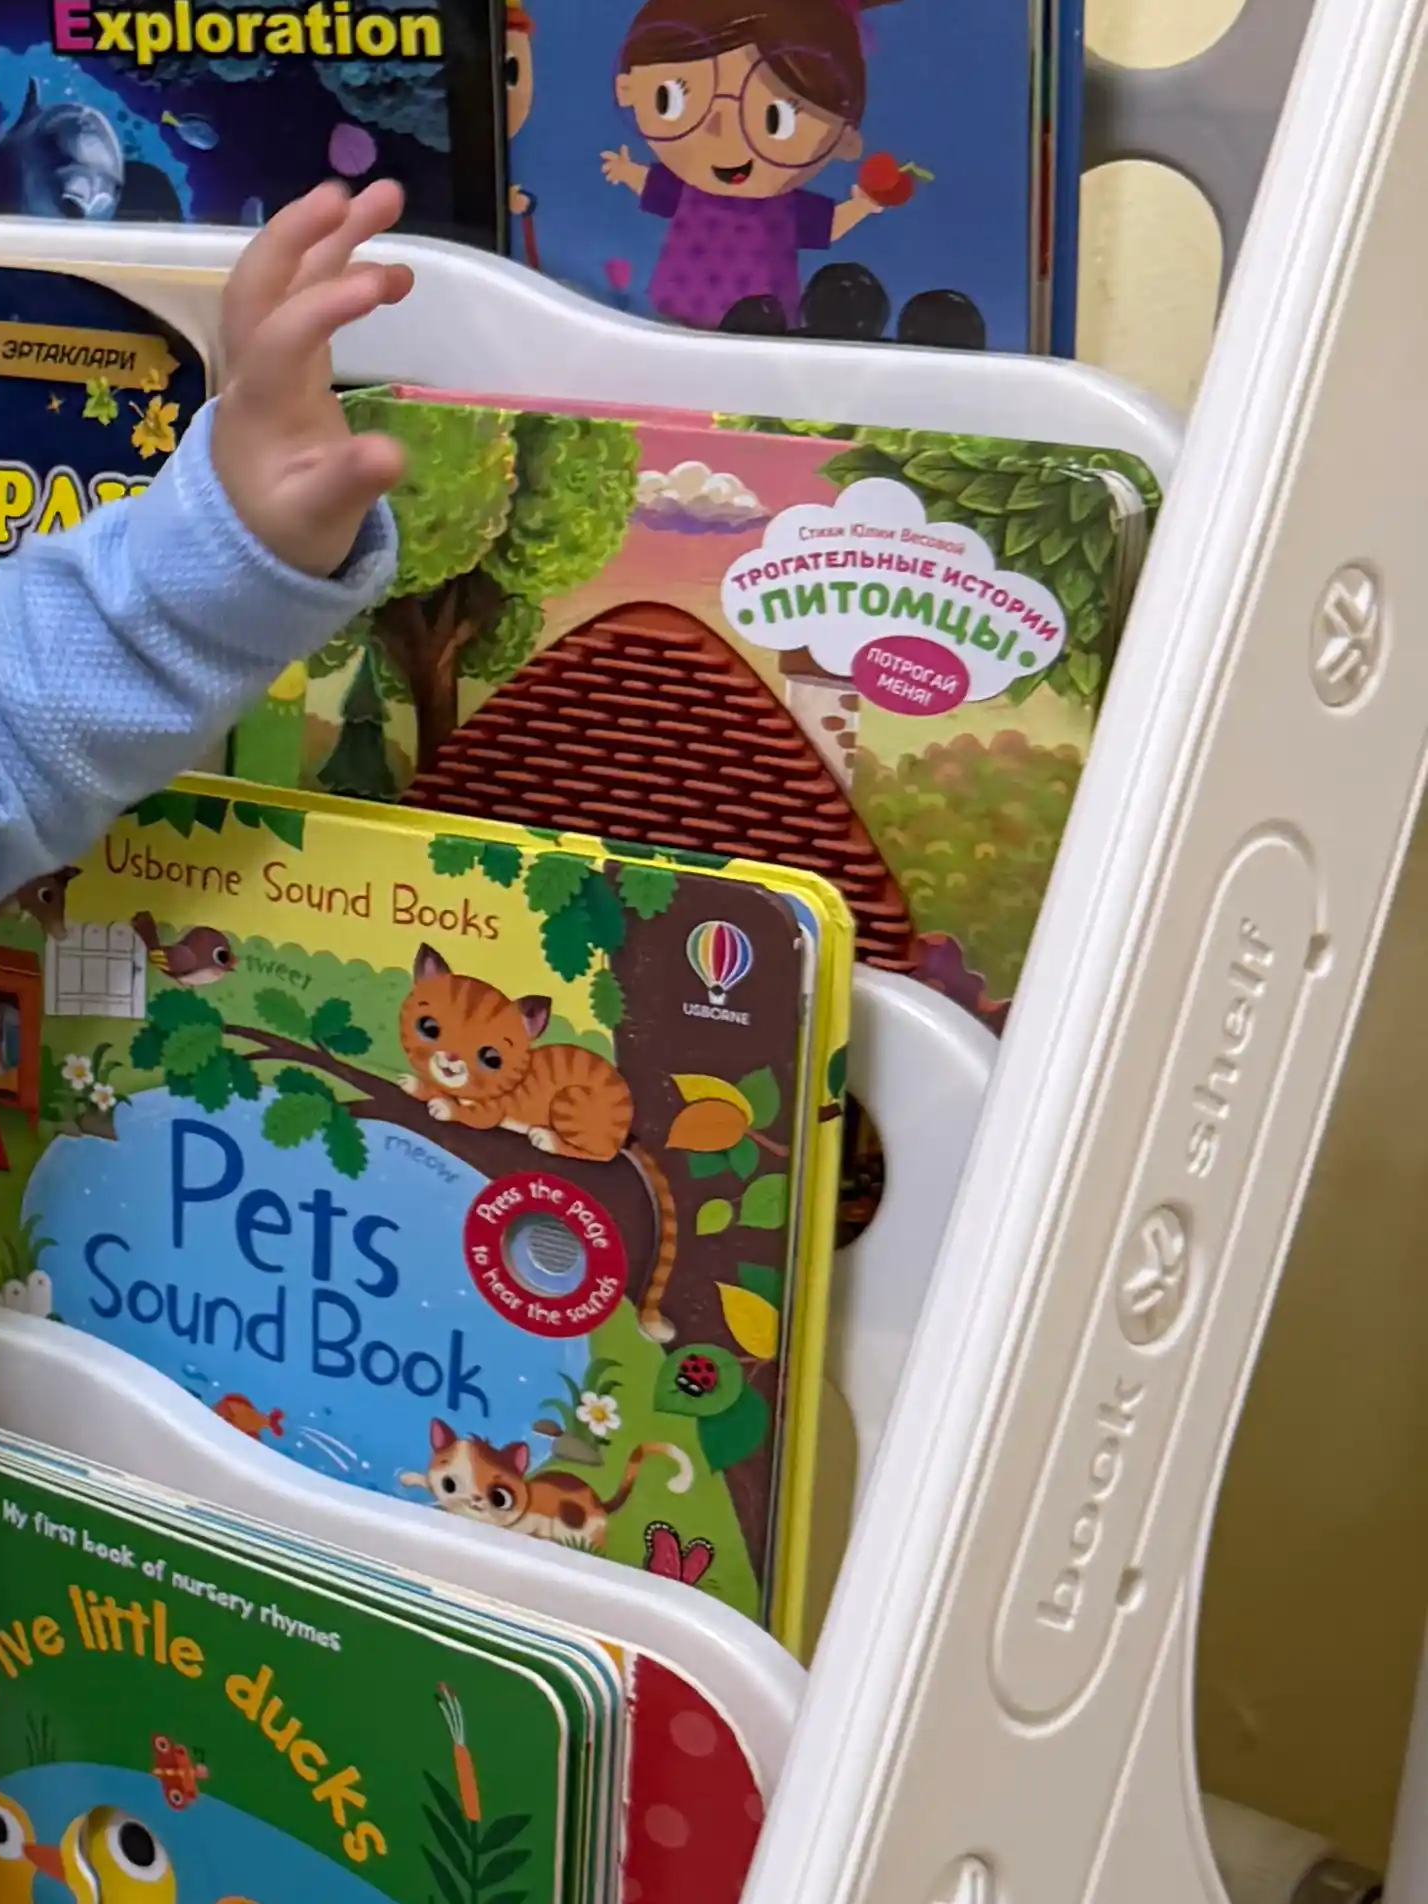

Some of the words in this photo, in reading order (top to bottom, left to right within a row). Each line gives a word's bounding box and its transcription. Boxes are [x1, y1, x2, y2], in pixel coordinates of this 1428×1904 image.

[53, 0, 442, 65] Exploration
[2, 339, 137, 371] ЭРТАКЛАРИ
[799, 524, 844, 541] Стихи
[849, 523, 896, 541] Юлии
[731, 550, 937, 591] ТРОГАТЕЛЬНЫЕ
[942, 566, 1060, 642] ИСТОРИИ
[760, 580, 1020, 661] ПИТОМЦЫ
[866, 646, 960, 695] ПОТРОГАЙ
[877, 672, 933, 707] МЕНЯ!
[105, 833, 243, 896] Usborne
[262, 860, 372, 919] Sound
[392, 883, 501, 941] Books
[245, 955, 313, 990] tweet
[682, 1002, 751, 1026] USBORNE
[383, 1132, 461, 1186] meow
[171, 1118, 400, 1299] Pets
[476, 1186, 525, 1225] Press
[528, 1178, 565, 1204] the
[566, 1200, 609, 1249] page
[471, 1245, 490, 1266] to
[482, 1267, 524, 1310] hear
[527, 1301, 561, 1326] the
[566, 1275, 619, 1323] sounds
[1036, 1373, 1147, 1632] book
[1187, 916, 1275, 1178] shelf
[83, 1232, 286, 1364] Sound
[311, 1287, 490, 1419] Book
[2, 1499, 28, 1529] My
[32, 1512, 79, 1546] first
[82, 1529, 136, 1568] book
[141, 1558, 166, 1582] of
[172, 1570, 254, 1620] nursery
[259, 1604, 342, 1652] rhymes
[68, 1584, 206, 1679] little
[224, 1664, 389, 1863] ducks
